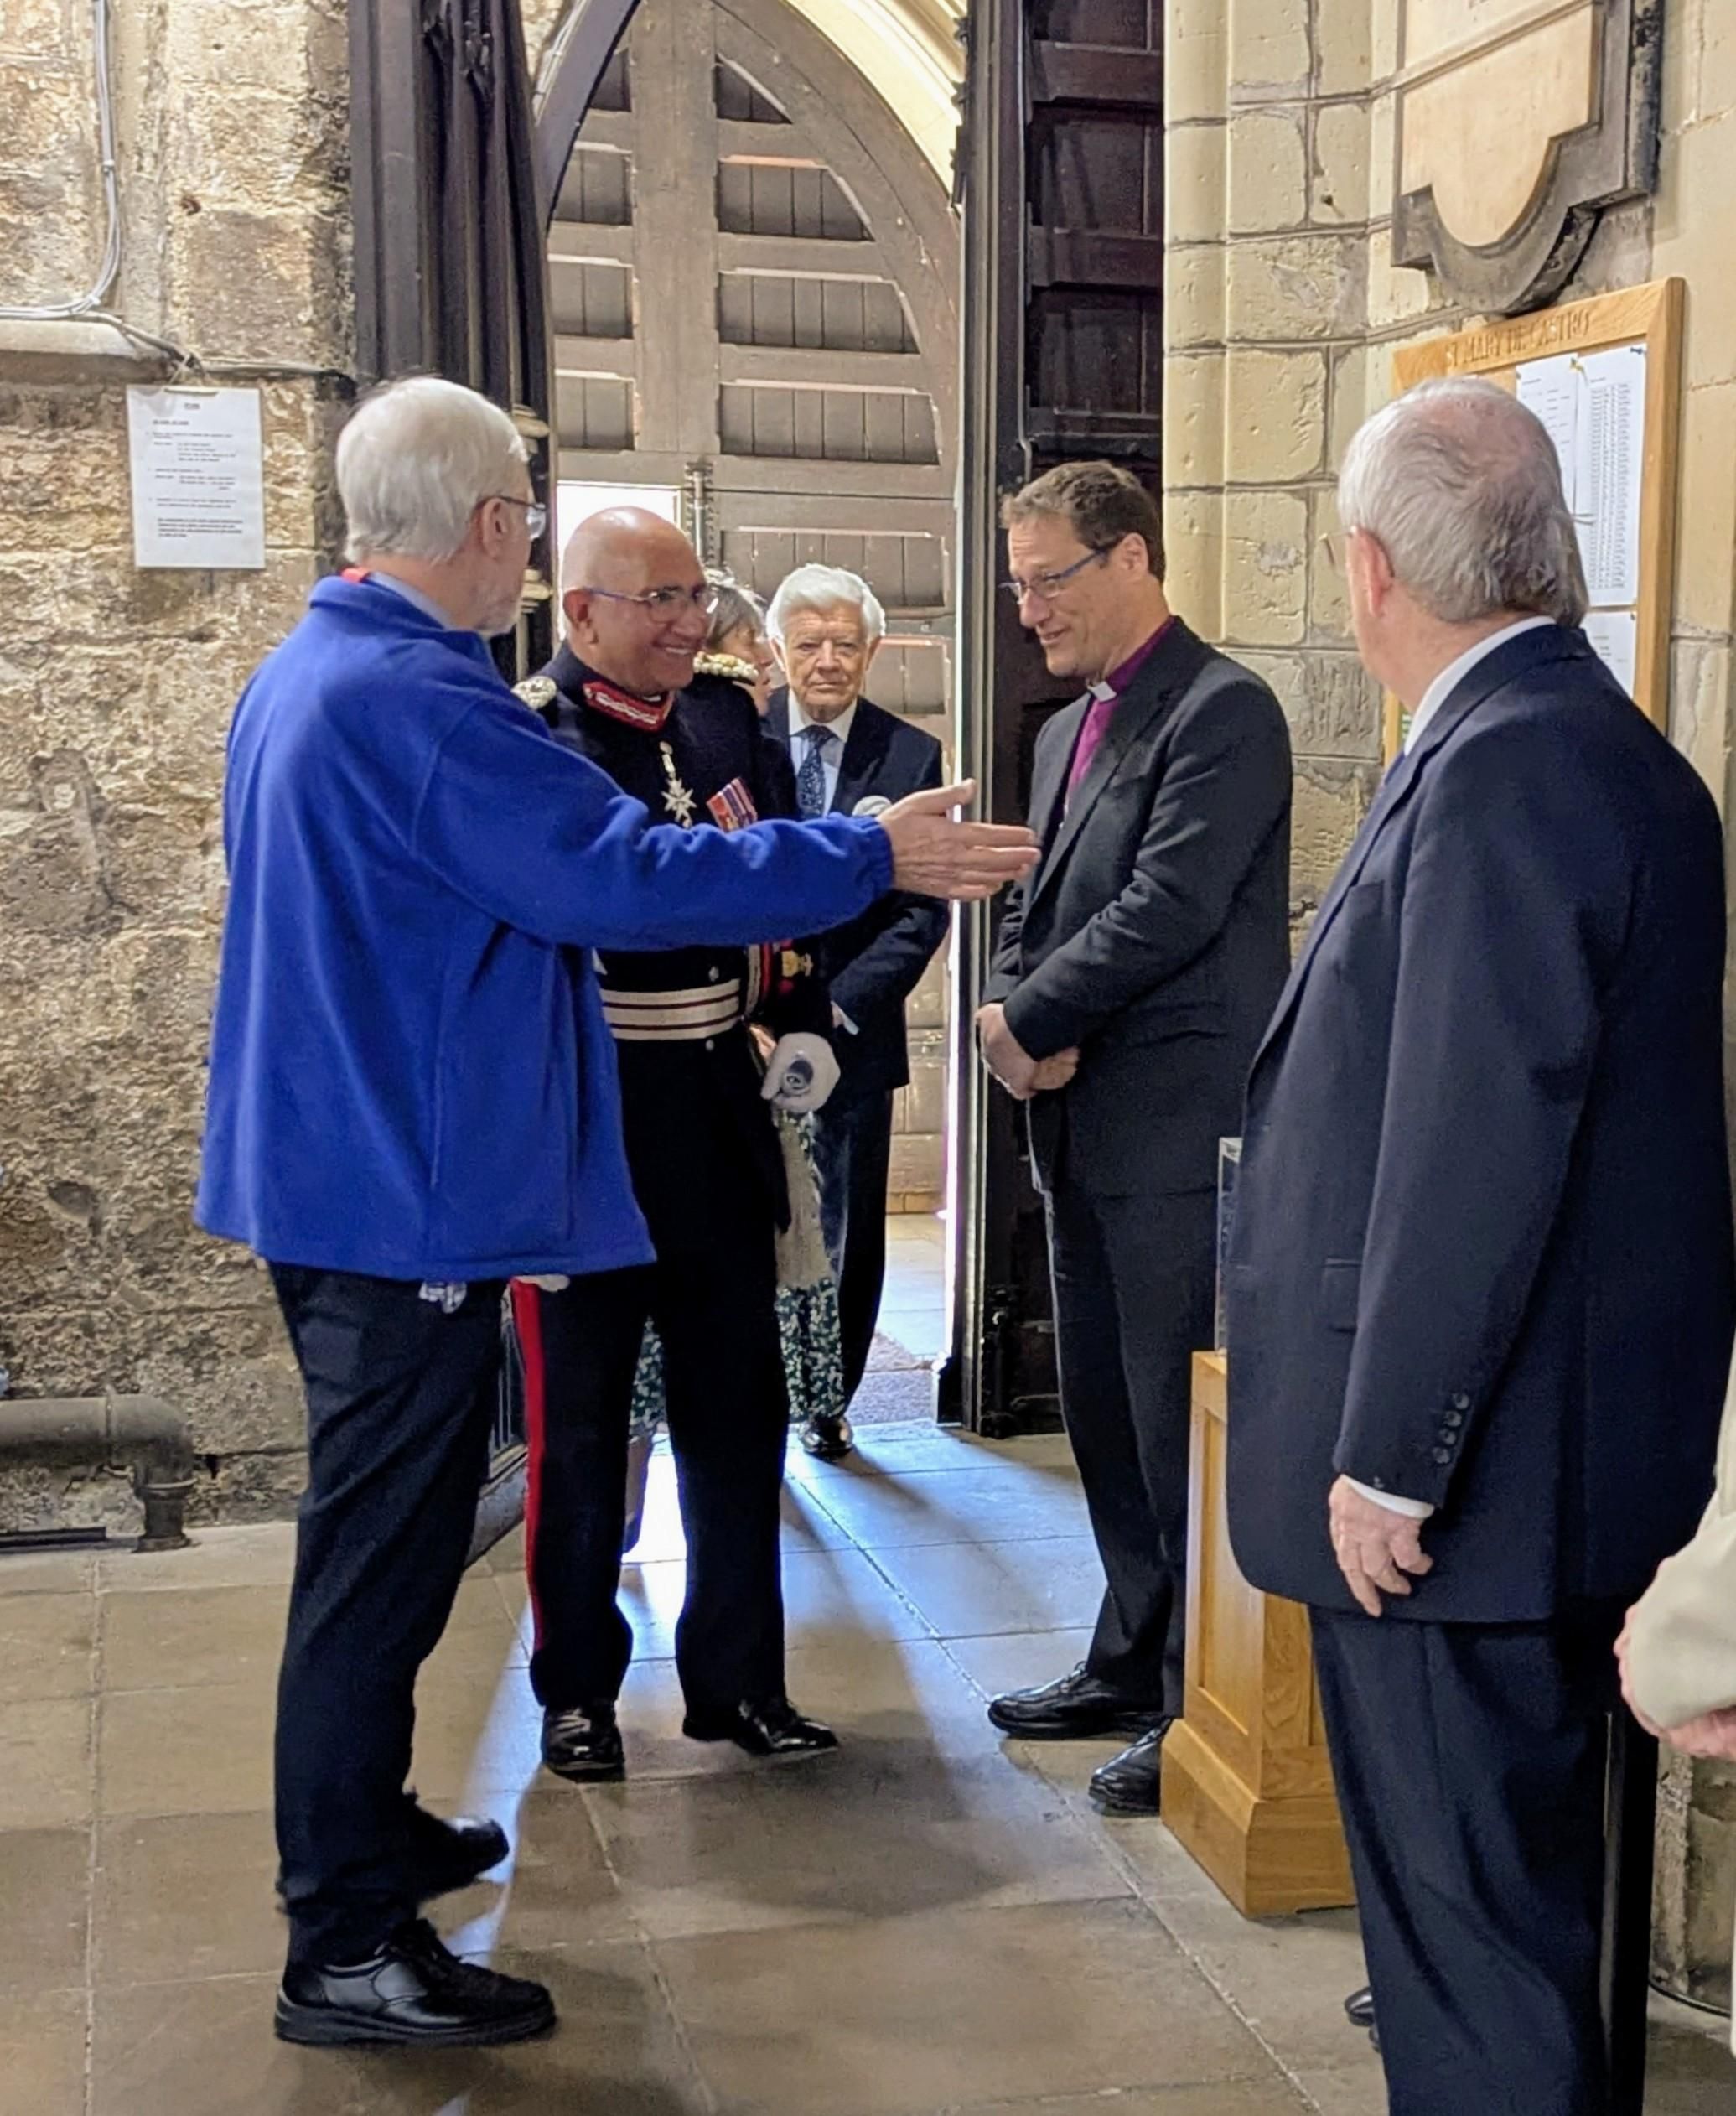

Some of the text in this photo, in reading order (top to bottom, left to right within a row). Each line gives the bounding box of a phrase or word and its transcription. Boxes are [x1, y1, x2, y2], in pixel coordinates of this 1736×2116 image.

[1464, 330, 1501, 364] MARY
[1506, 324, 1527, 354] DE
[1531, 309, 1590, 347] CASTRO
